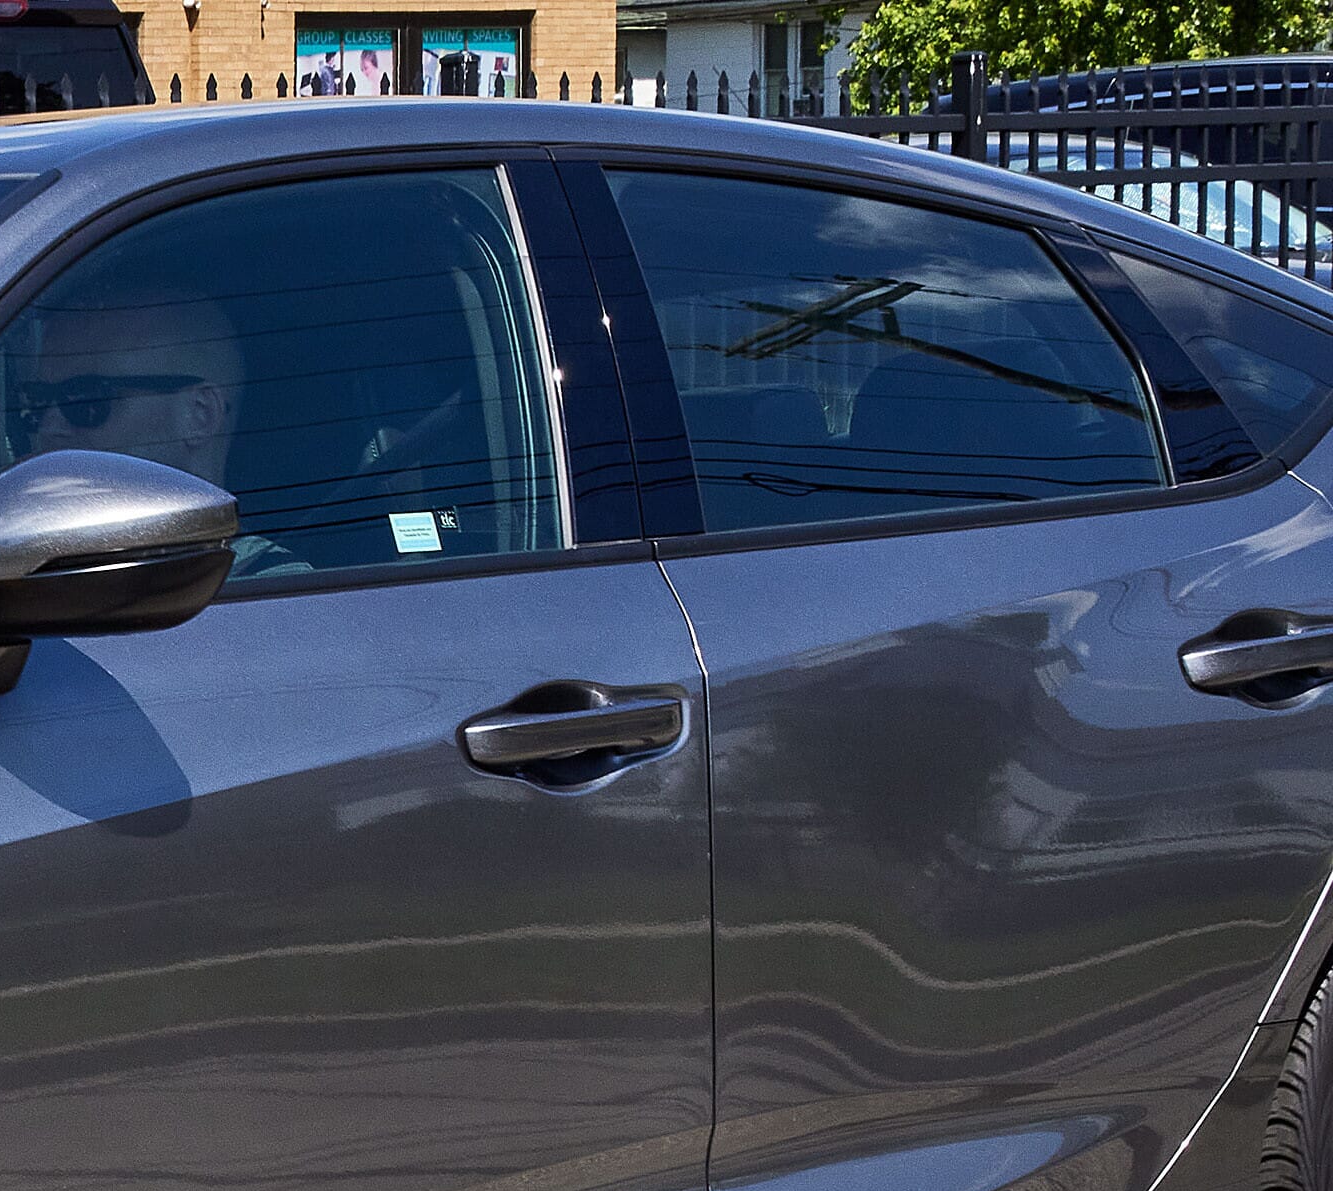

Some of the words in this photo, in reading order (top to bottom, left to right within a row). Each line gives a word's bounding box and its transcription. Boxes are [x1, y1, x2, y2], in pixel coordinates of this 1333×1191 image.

[345, 31, 392, 44] CLASSES
[423, 30, 464, 43] NVITING
[473, 29, 511, 41] SPACES
